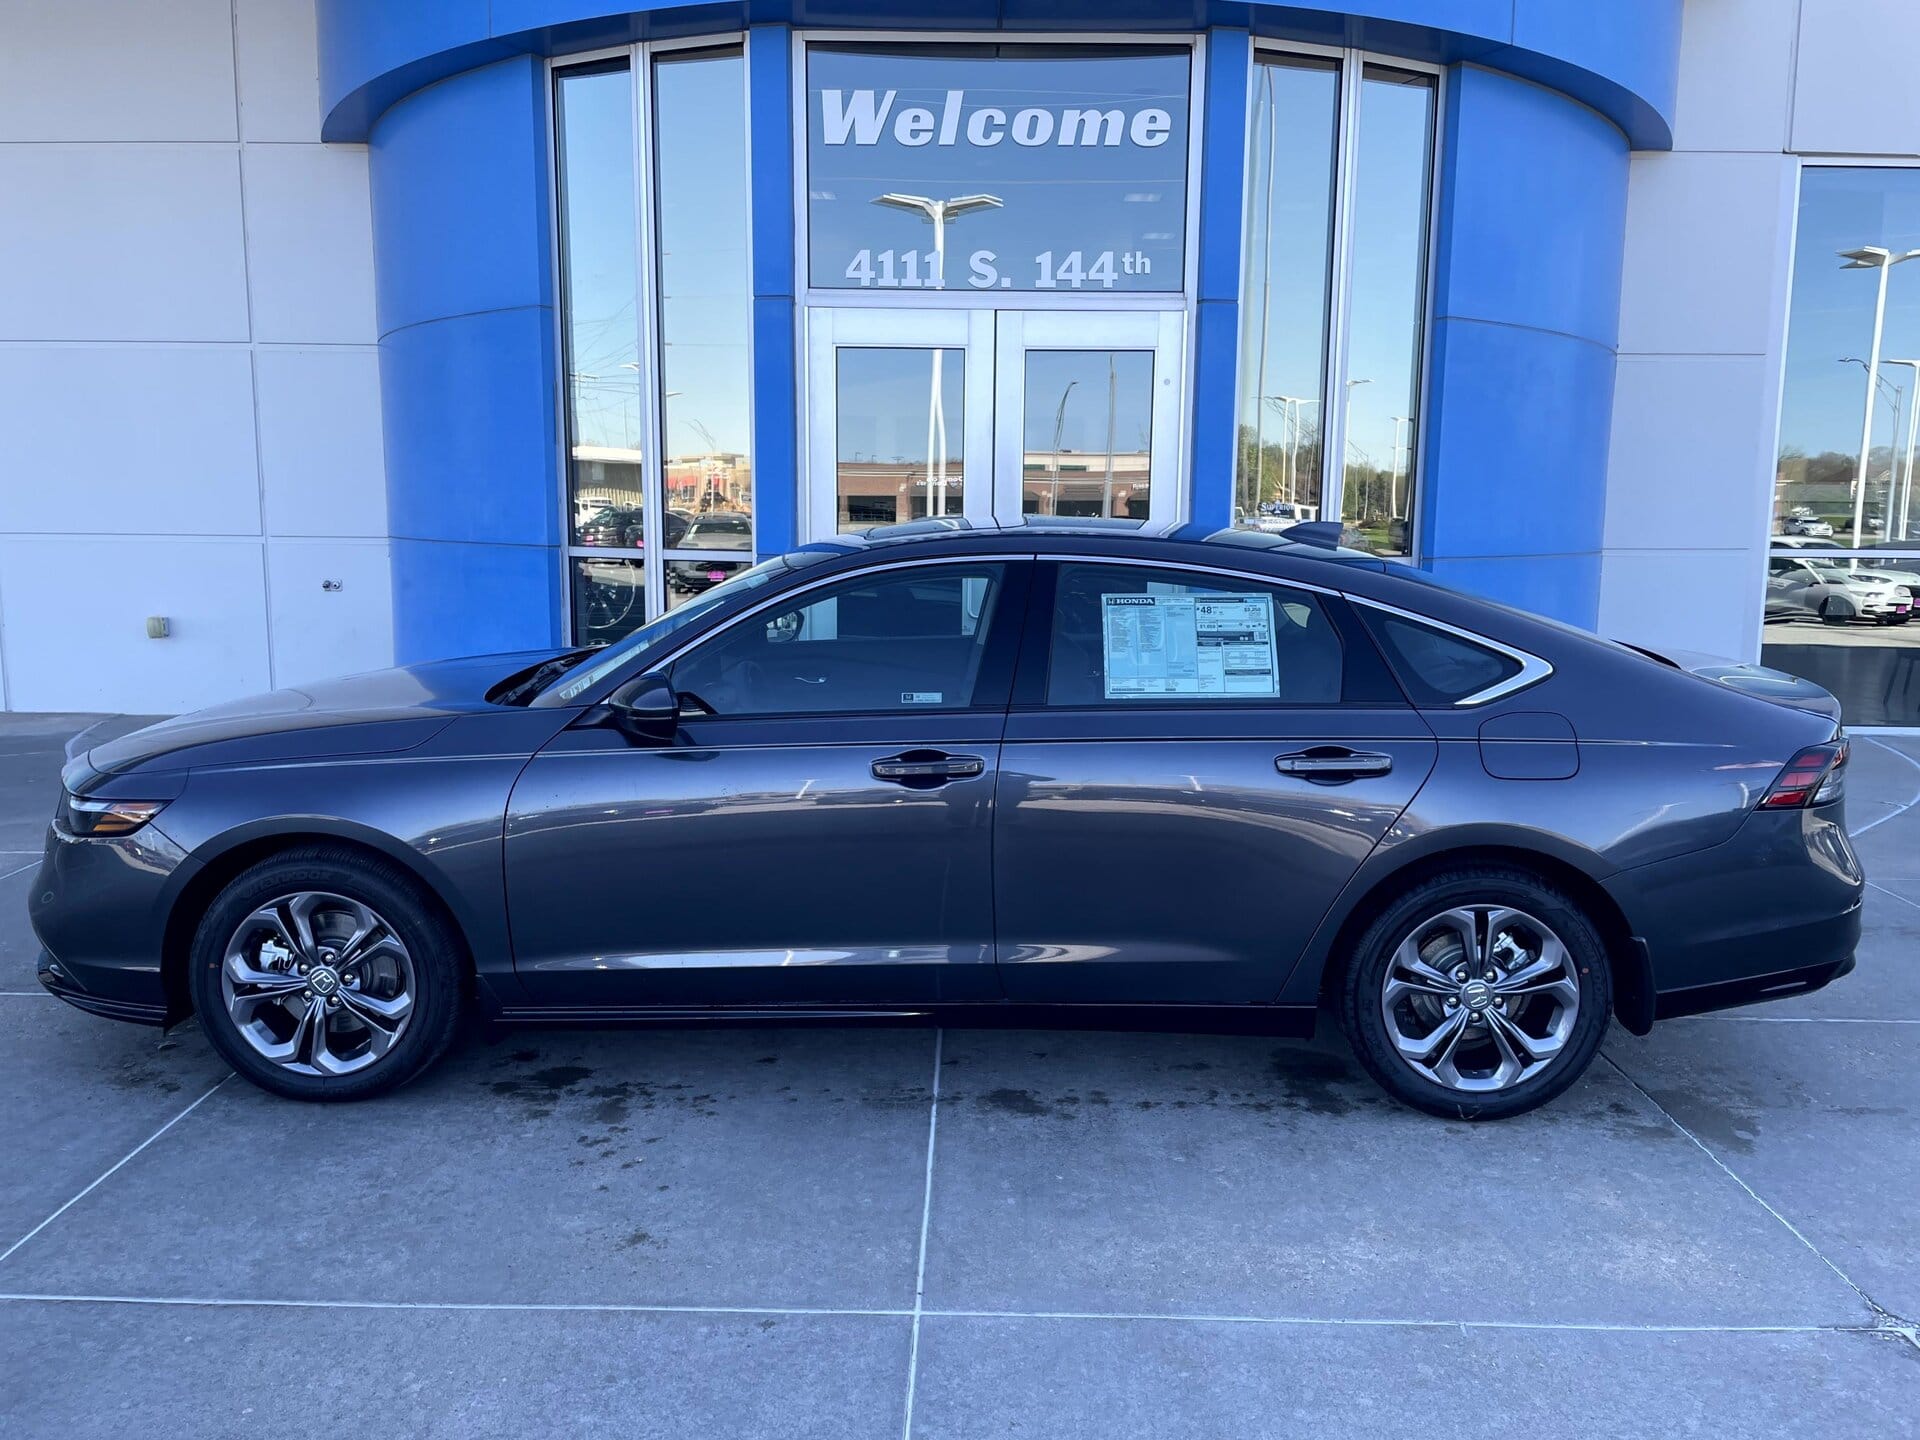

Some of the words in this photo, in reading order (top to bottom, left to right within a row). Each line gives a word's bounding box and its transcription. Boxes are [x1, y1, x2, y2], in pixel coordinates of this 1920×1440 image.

[821, 89, 1172, 147] Welcome
[845, 249, 945, 287] 4111
[967, 250, 1011, 288] S.
[1035, 251, 1150, 288] 144th
[1200, 606, 1212, 614] 48
